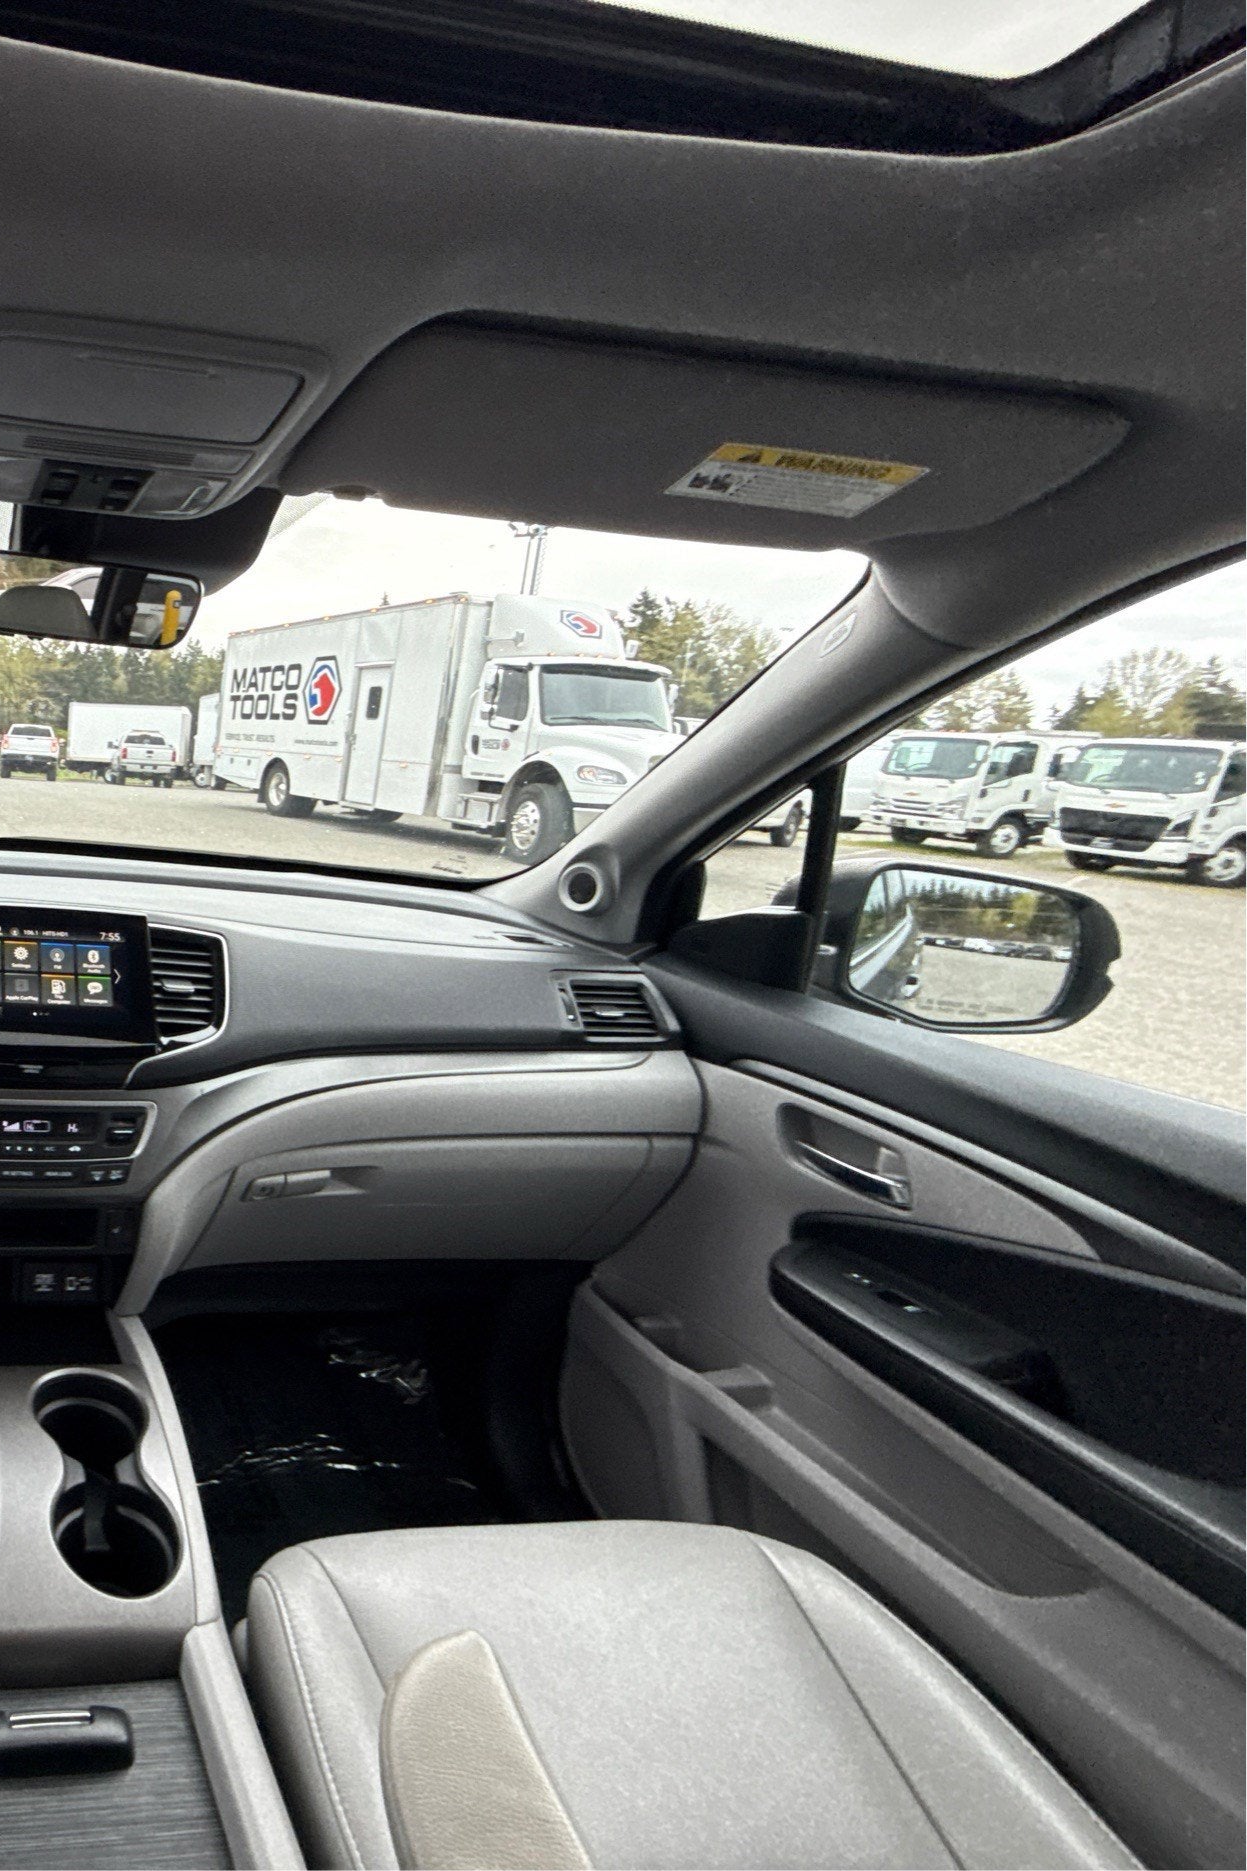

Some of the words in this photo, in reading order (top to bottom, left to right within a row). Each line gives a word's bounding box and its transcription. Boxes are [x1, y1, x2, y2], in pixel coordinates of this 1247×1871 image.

[231, 663, 302, 693] MATCO
[230, 693, 298, 720] TOOLS
[99, 931, 121, 942] 7:55
